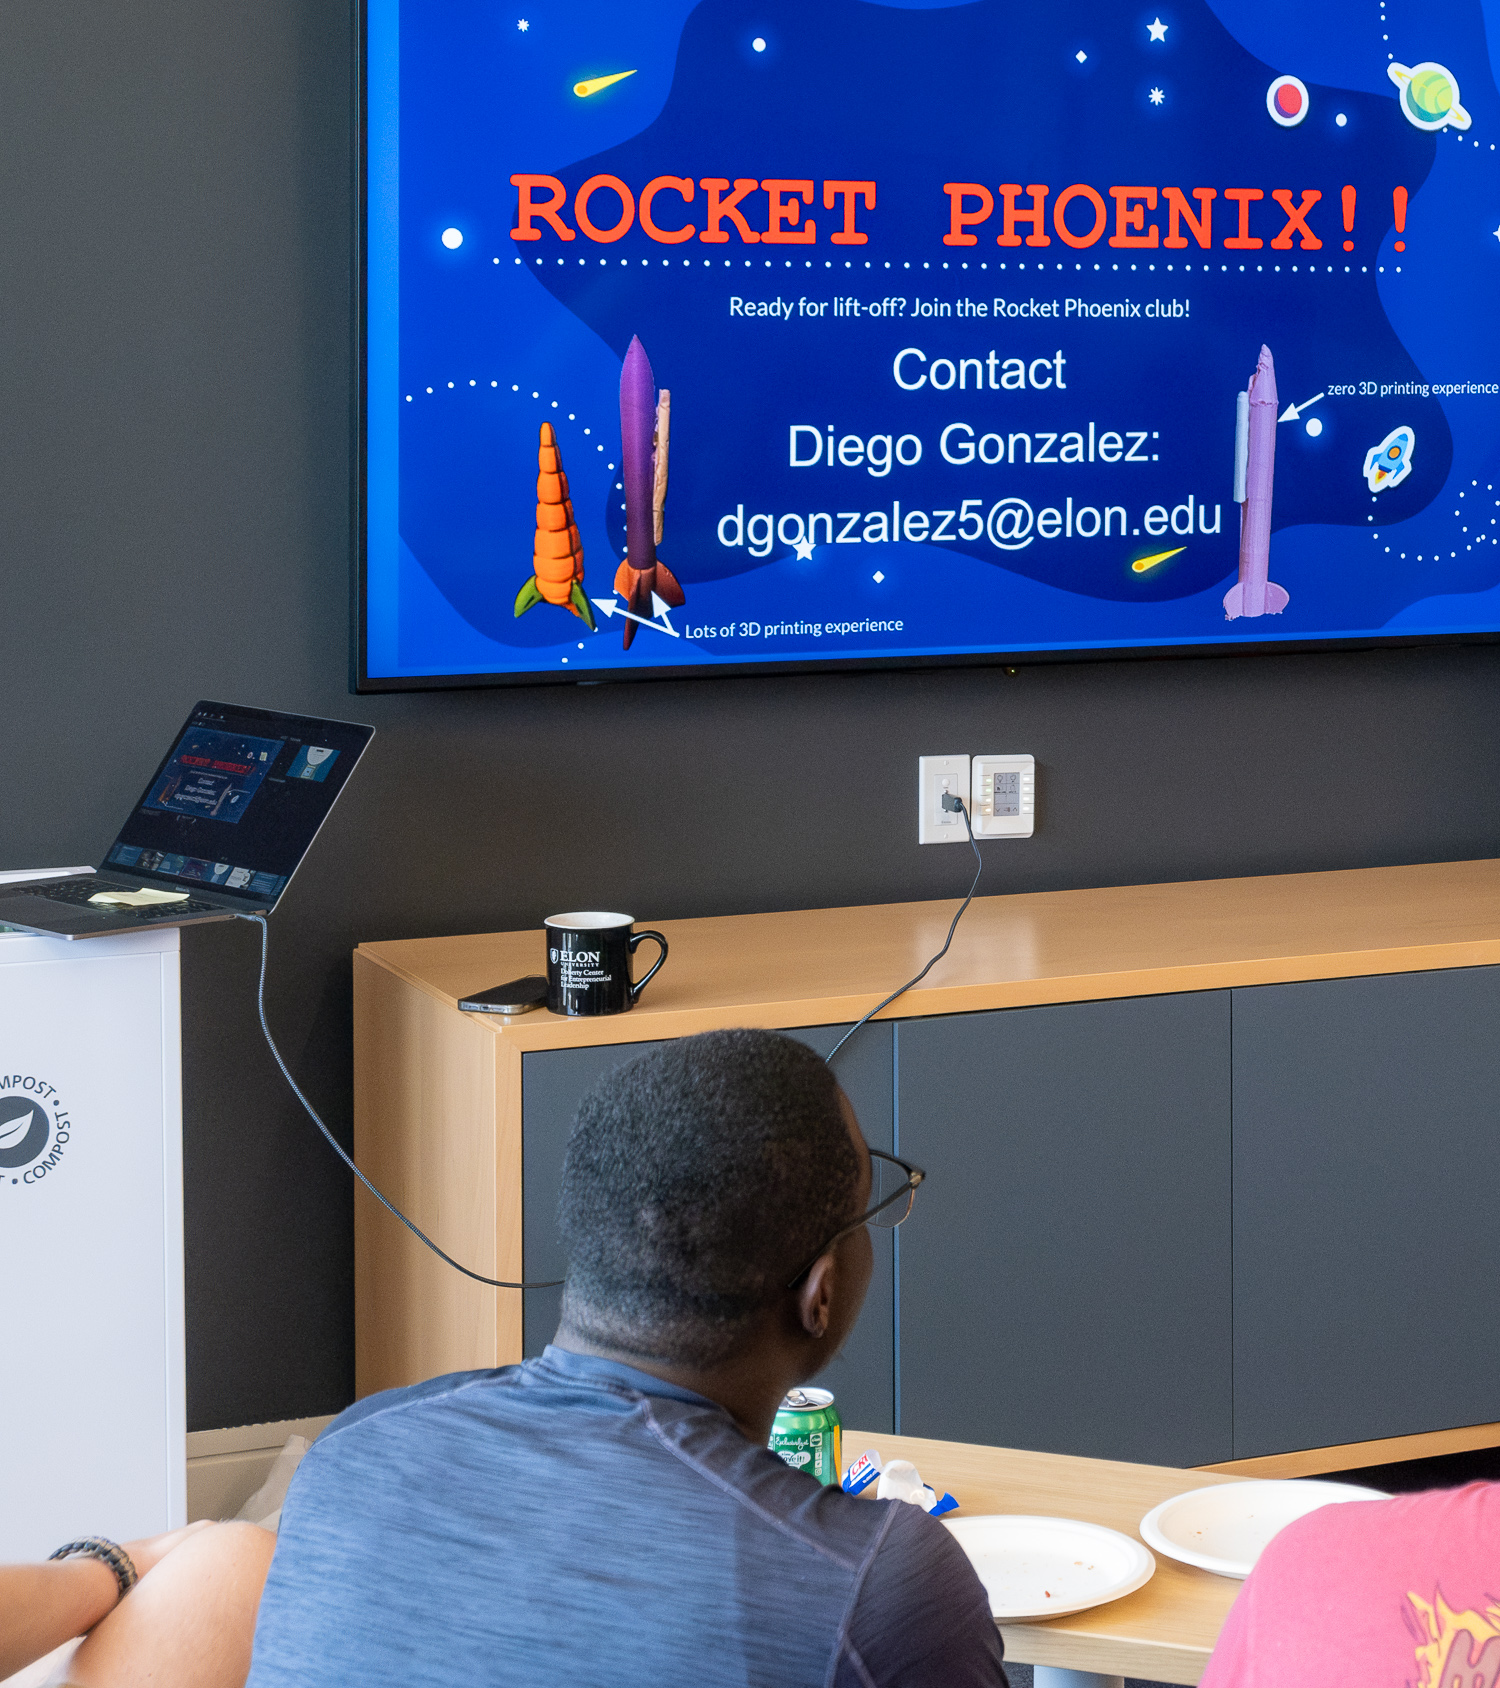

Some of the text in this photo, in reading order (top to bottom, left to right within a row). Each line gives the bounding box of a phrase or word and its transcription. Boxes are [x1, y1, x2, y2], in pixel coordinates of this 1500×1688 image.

[509, 173, 1409, 253] ROCKET PHOENIX!!
[730, 296, 1190, 321] Ready for lift-off? Join the Rocket Phoenix club!
[893, 347, 1067, 391] Contact
[1327, 380, 1499, 398] zero 3D printing experience
[789, 421, 1159, 478] Diego Gonzalez:
[717, 494, 1221, 557] dgonzalez5@elon.edu
[685, 617, 904, 639] Lots of 3D printing experience
[560, 950, 600, 963] ELON
[23, 1111, 71, 1184] COMPOST
